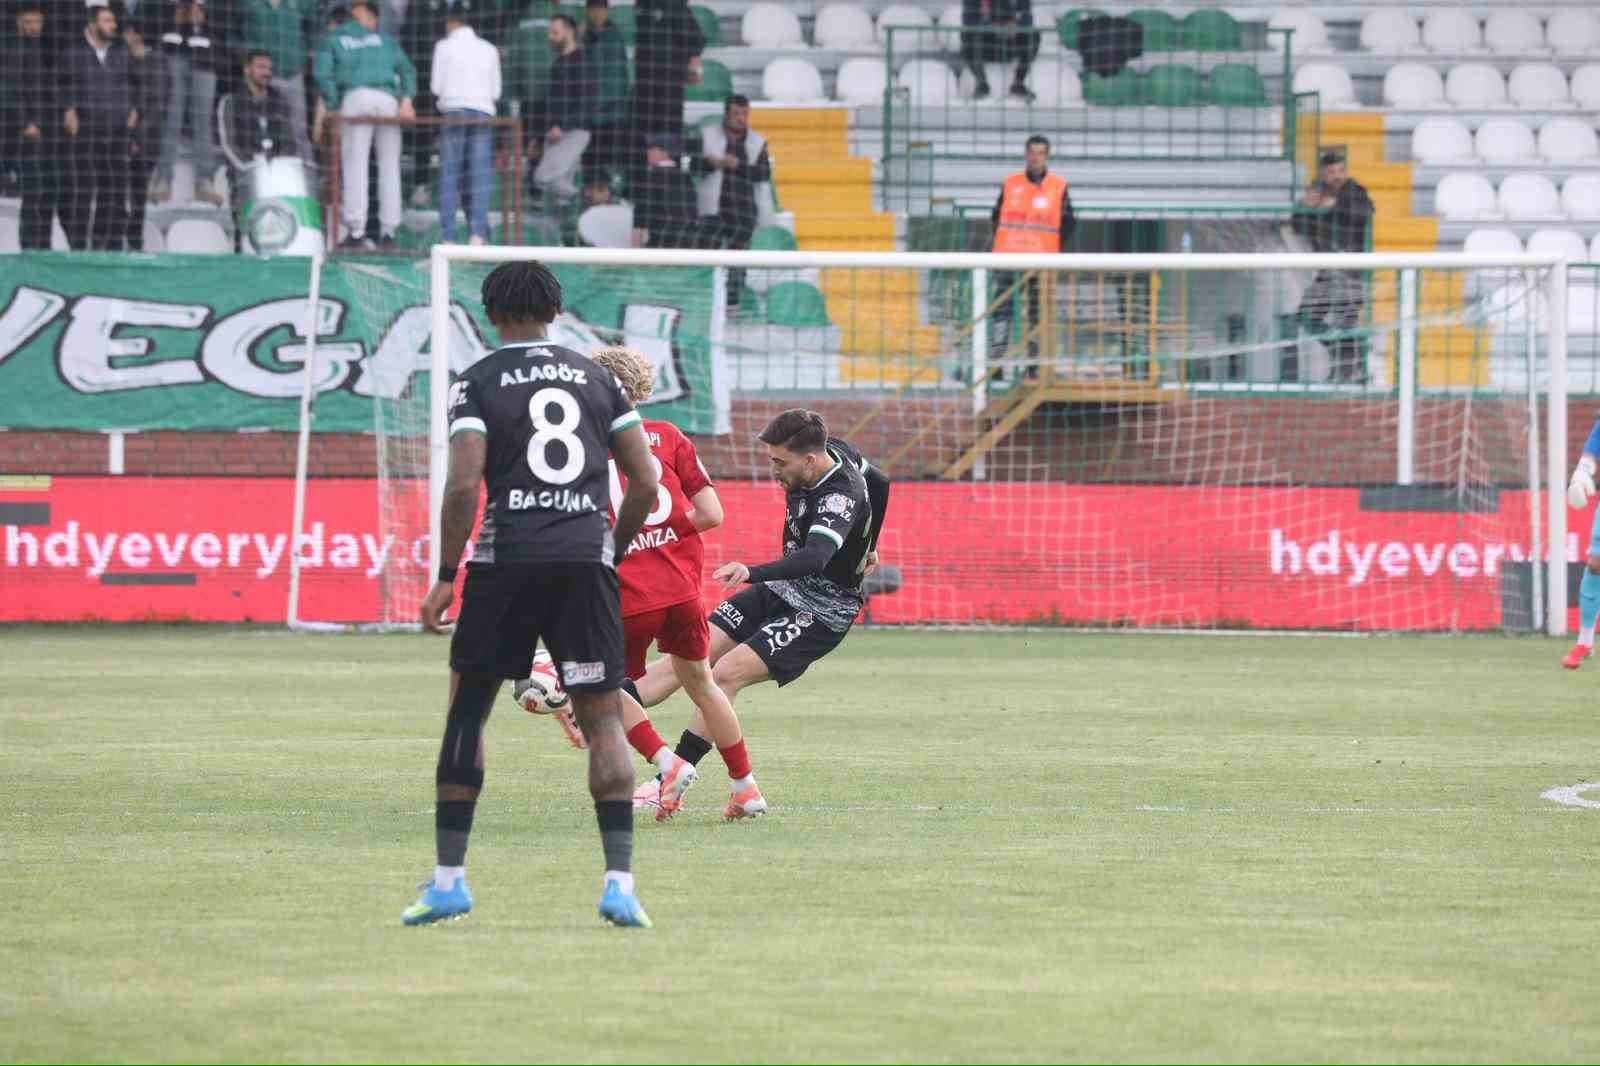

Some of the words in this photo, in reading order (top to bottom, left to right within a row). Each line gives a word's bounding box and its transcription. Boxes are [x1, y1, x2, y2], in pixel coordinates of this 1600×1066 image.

[500, 363, 588, 388] ALAGÖZ
[527, 387, 586, 486] 8
[623, 527, 679, 555] AMZA
[718, 599, 745, 627] DELTA
[761, 616, 801, 647] 23
